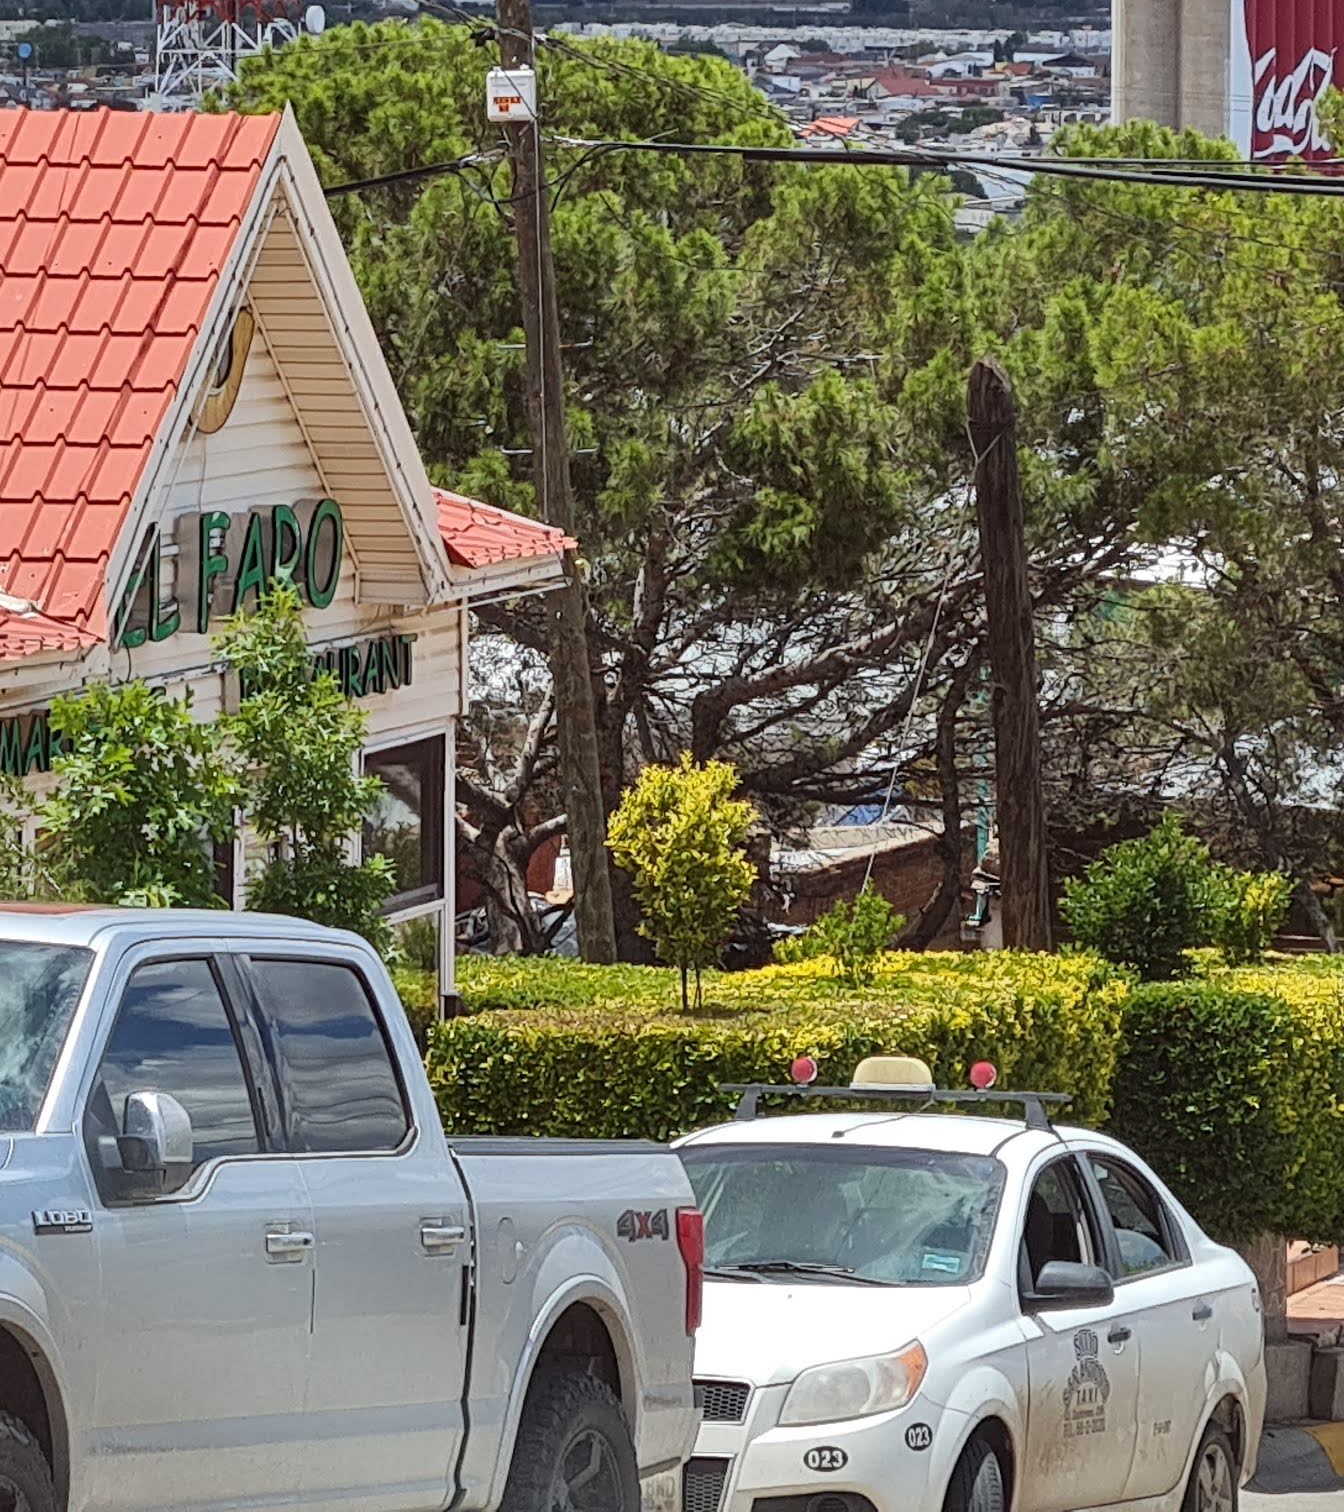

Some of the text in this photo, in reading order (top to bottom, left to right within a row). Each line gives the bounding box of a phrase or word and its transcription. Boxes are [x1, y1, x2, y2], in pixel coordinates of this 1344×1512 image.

[197, 498, 343, 635] FARO
[32, 1208, 93, 1226] LOBO
[1076, 1388, 1099, 1406] TAXI
[908, 1427, 930, 1446] 023
[807, 1450, 844, 1468] 023
